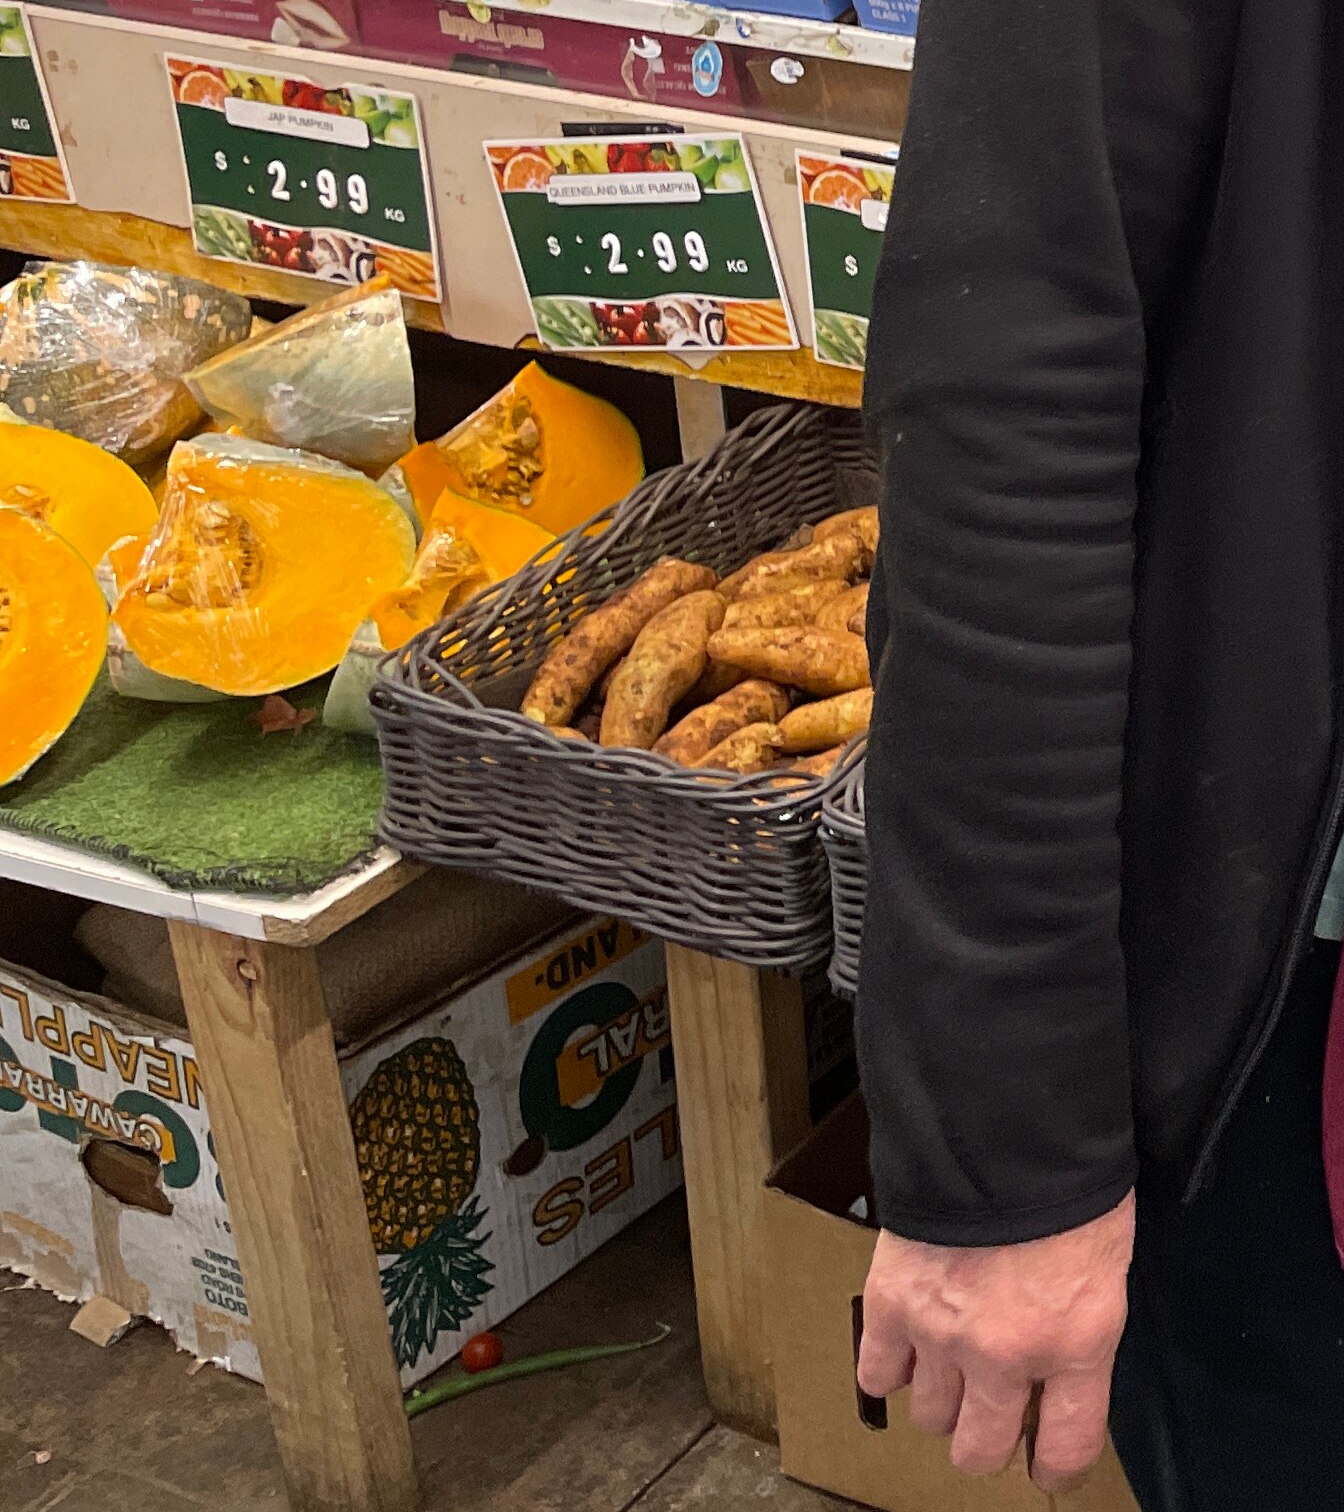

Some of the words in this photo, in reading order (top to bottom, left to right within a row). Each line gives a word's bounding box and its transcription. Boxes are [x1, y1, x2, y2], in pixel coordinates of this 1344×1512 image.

[12, 117, 30, 131] KG
[268, 112, 286, 126] JAP
[288, 114, 335, 133] PUMPKIN
[267, 159, 369, 214] 2.99
[384, 206, 407, 223] KG
[550, 183, 617, 198] QUEENSLAND
[620, 183, 647, 195] BLUE
[649, 182, 696, 194] PUMPKIN
[601, 230, 709, 274] 2.99
[726, 259, 749, 273] KG
[844, 254, 859, 277] $
